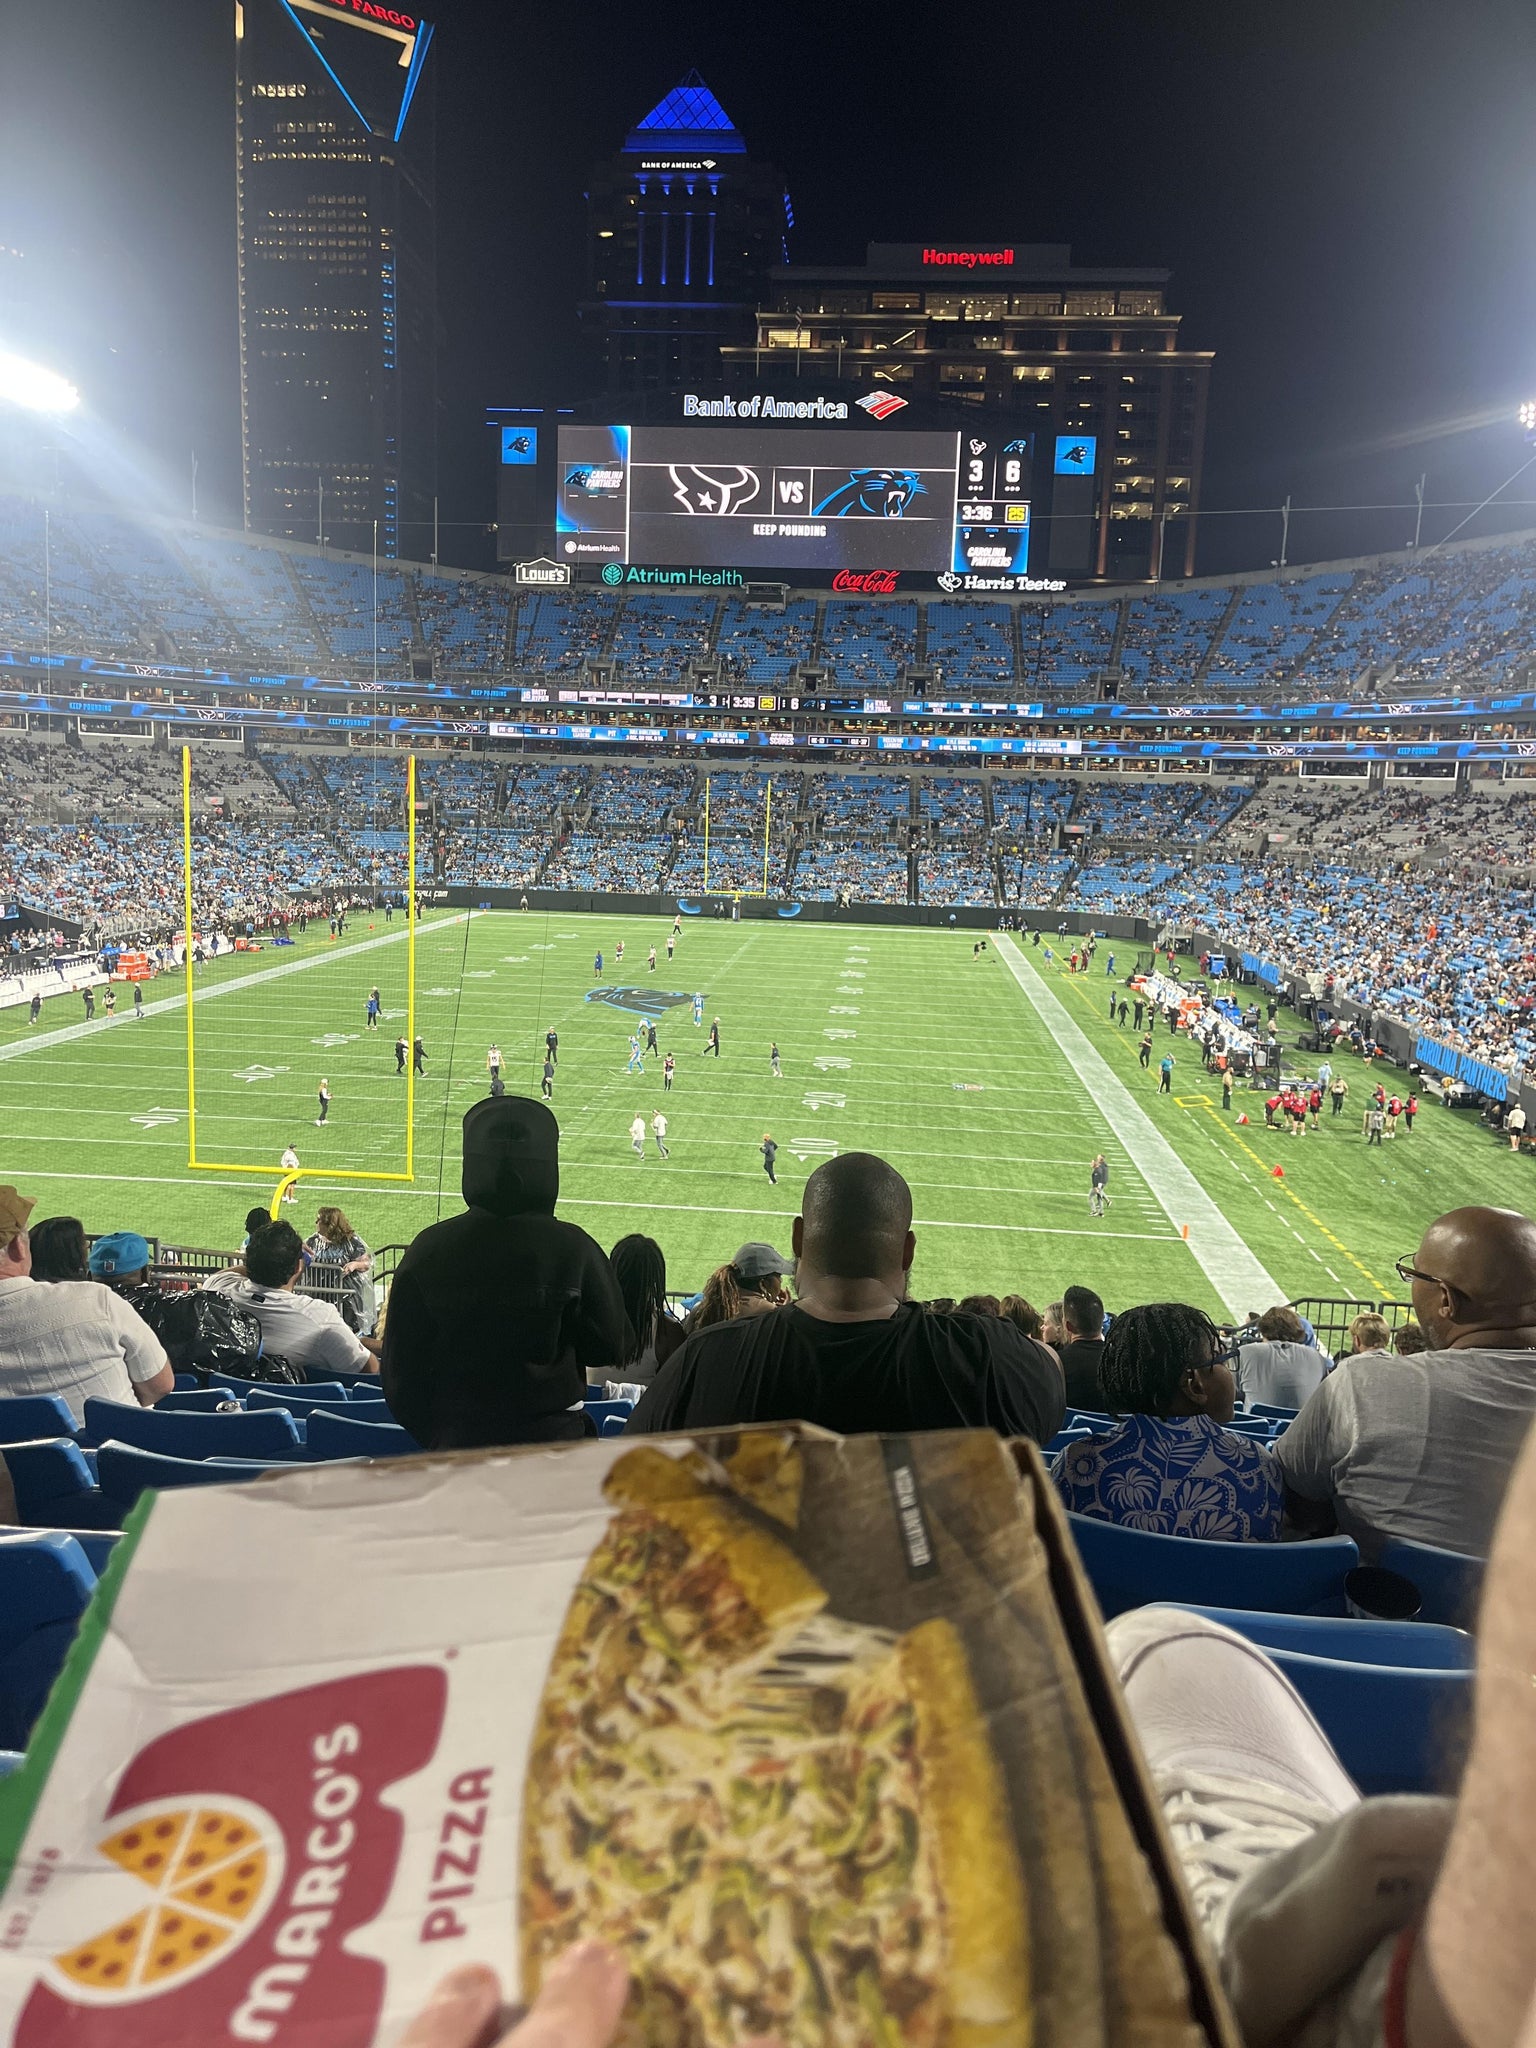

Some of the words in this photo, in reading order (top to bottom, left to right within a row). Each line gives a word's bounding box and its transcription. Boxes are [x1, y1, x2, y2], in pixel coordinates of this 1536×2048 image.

[351, 0, 416, 29] FARGO
[923, 249, 1014, 269] Honeywell
[683, 394, 737, 417] Bank
[738, 395, 761, 418] of
[761, 396, 848, 419] America
[590, 471, 624, 480] CAROLINA
[969, 460, 984, 482] 3
[1006, 460, 1021, 483] 6
[586, 479, 621, 489] PANTHERS
[779, 481, 804, 504] VS
[962, 505, 993, 521] 3:36
[753, 523, 777, 536] KEEP
[779, 524, 827, 537] POUNDING
[577, 544, 600, 552] Atrium
[967, 547, 1007, 557] CAROLINA
[521, 567, 565, 582] LOWE'S
[626, 567, 687, 584] Atrium
[689, 568, 743, 586] Health
[964, 575, 1014, 590] Harris
[1017, 576, 1067, 591] Teeter
[709, 695, 717, 707] 3
[791, 698, 799, 710] 6
[1416, 1035, 1459, 1077] CAROLINA
[1458, 1054, 1509, 1102] PANTHERS
[419, 1766, 496, 1943] PIZZA
[228, 1722, 362, 2042] MARCO'S
